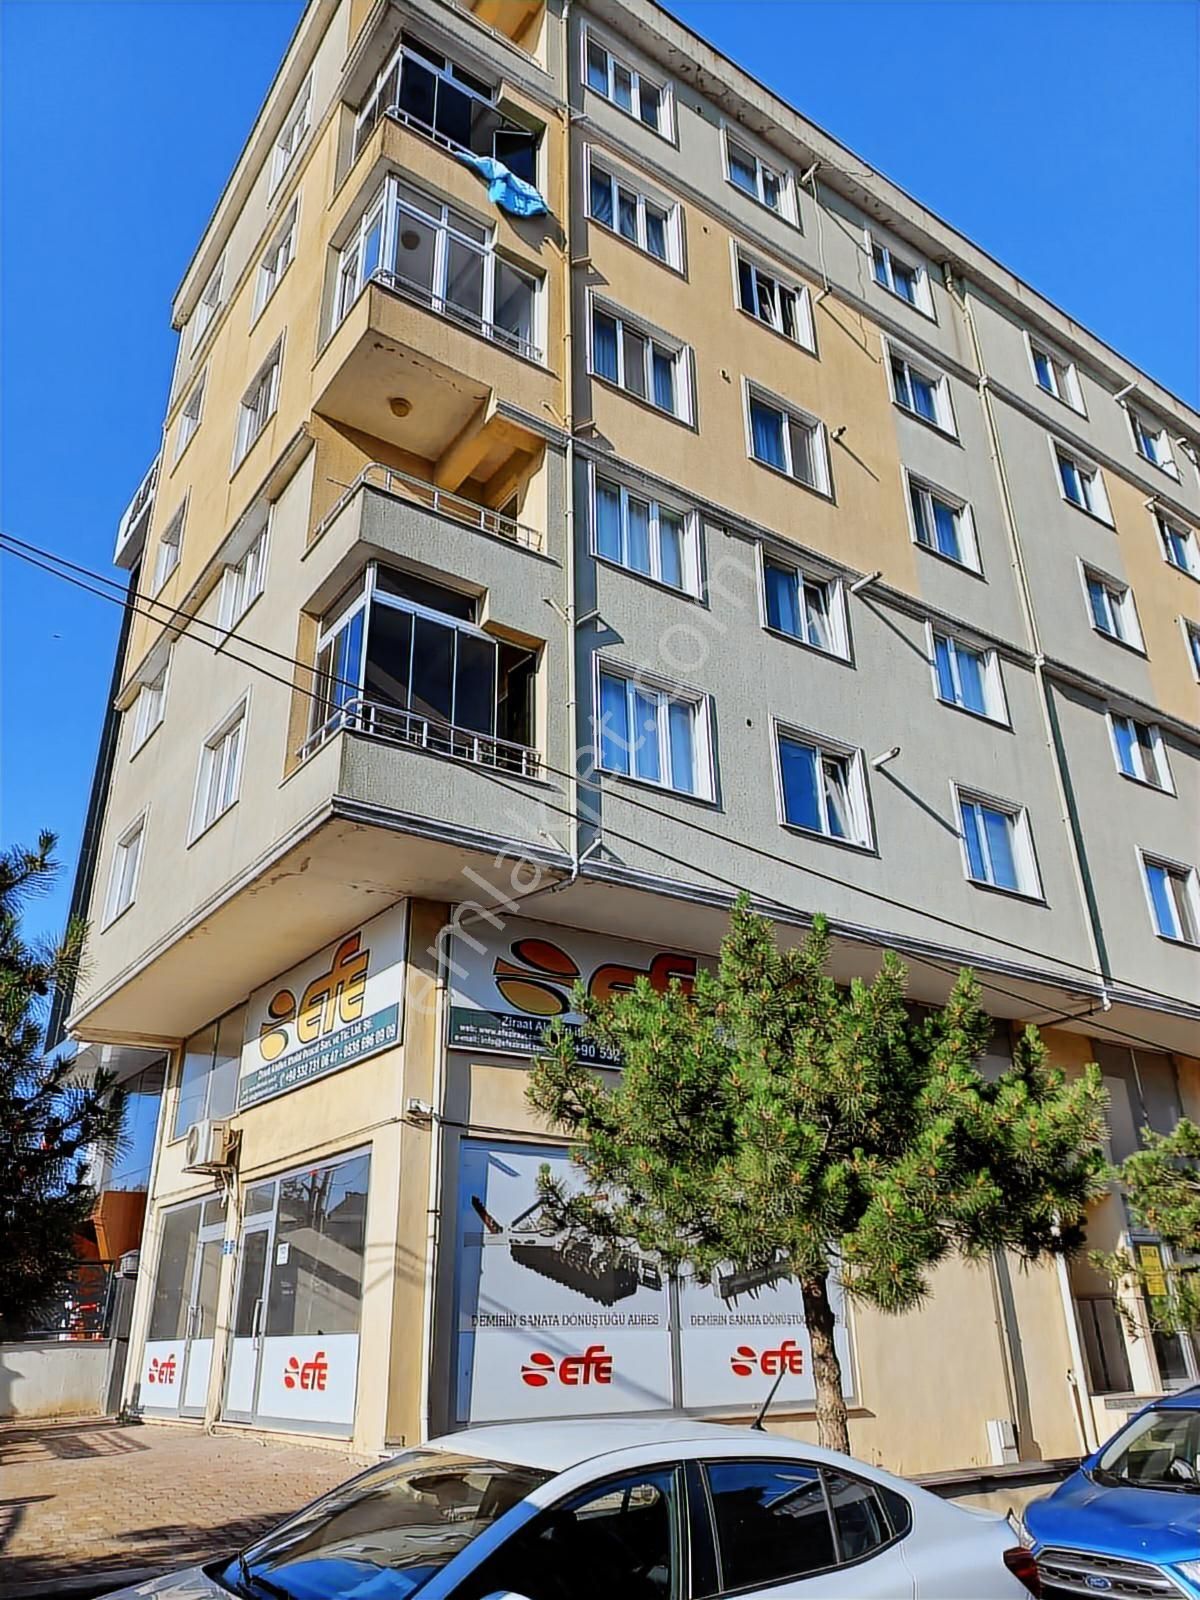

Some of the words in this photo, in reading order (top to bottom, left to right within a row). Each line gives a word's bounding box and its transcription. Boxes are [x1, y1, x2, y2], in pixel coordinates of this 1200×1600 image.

[502, 1015, 533, 1030] Ziraat
[574, 1044, 595, 1058] +90
[519, 1314, 559, 1327] SANATA
[562, 1312, 625, 1328] DÖNÜŞTÜĞÜ
[627, 1313, 659, 1326] ADRES
[729, 1313, 761, 1326] SANATA
